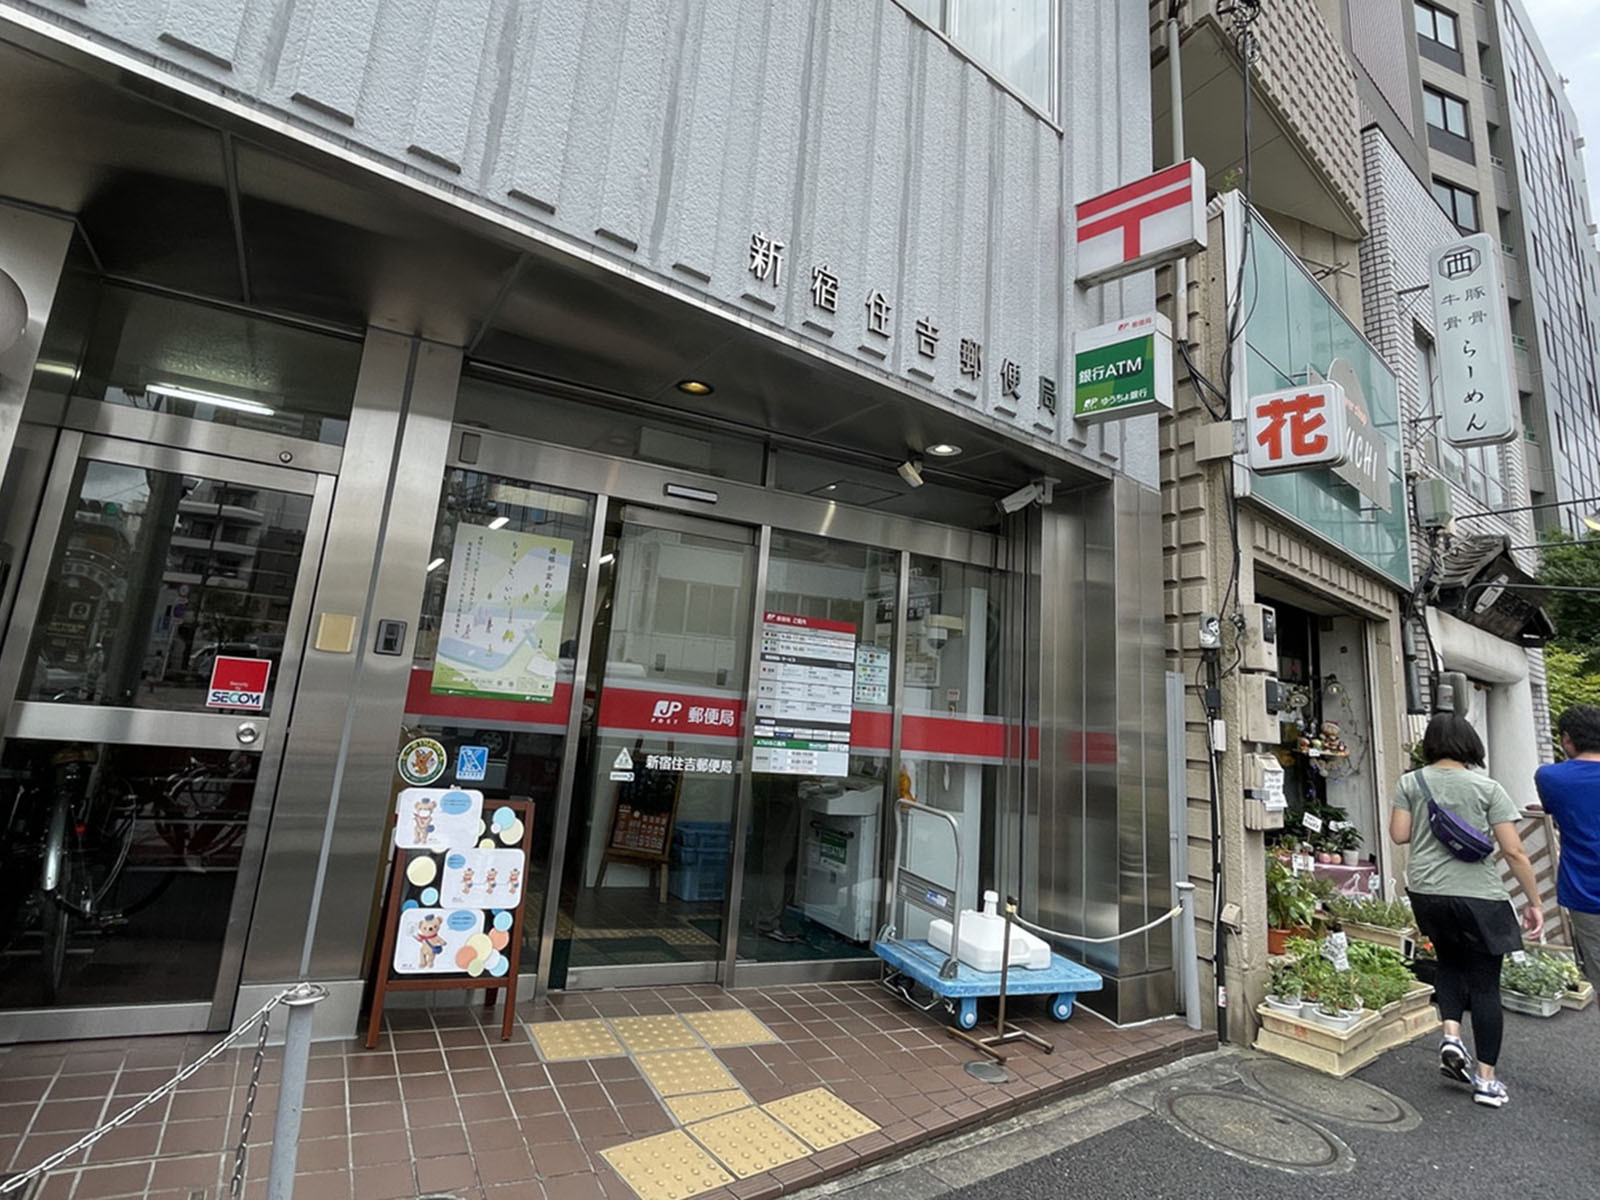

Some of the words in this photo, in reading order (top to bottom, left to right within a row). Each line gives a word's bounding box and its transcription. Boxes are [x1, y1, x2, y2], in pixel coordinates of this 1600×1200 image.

[1441, 294, 1462, 331] 牛骨
[1464, 285, 1487, 326] 豚骨
[748, 231, 1056, 415] 新宿住吉郵便局
[1078, 356, 1142, 384] 銀行ATM
[1463, 340, 1487, 432] らーめん
[1100, 388, 1147, 405] ゆうちょ銀行
[1256, 393, 1328, 461] 花
[211, 691, 260, 705] SECOM
[687, 706, 735, 727] 郵便局
[645, 755, 733, 774] 新宿住吉郵便局
